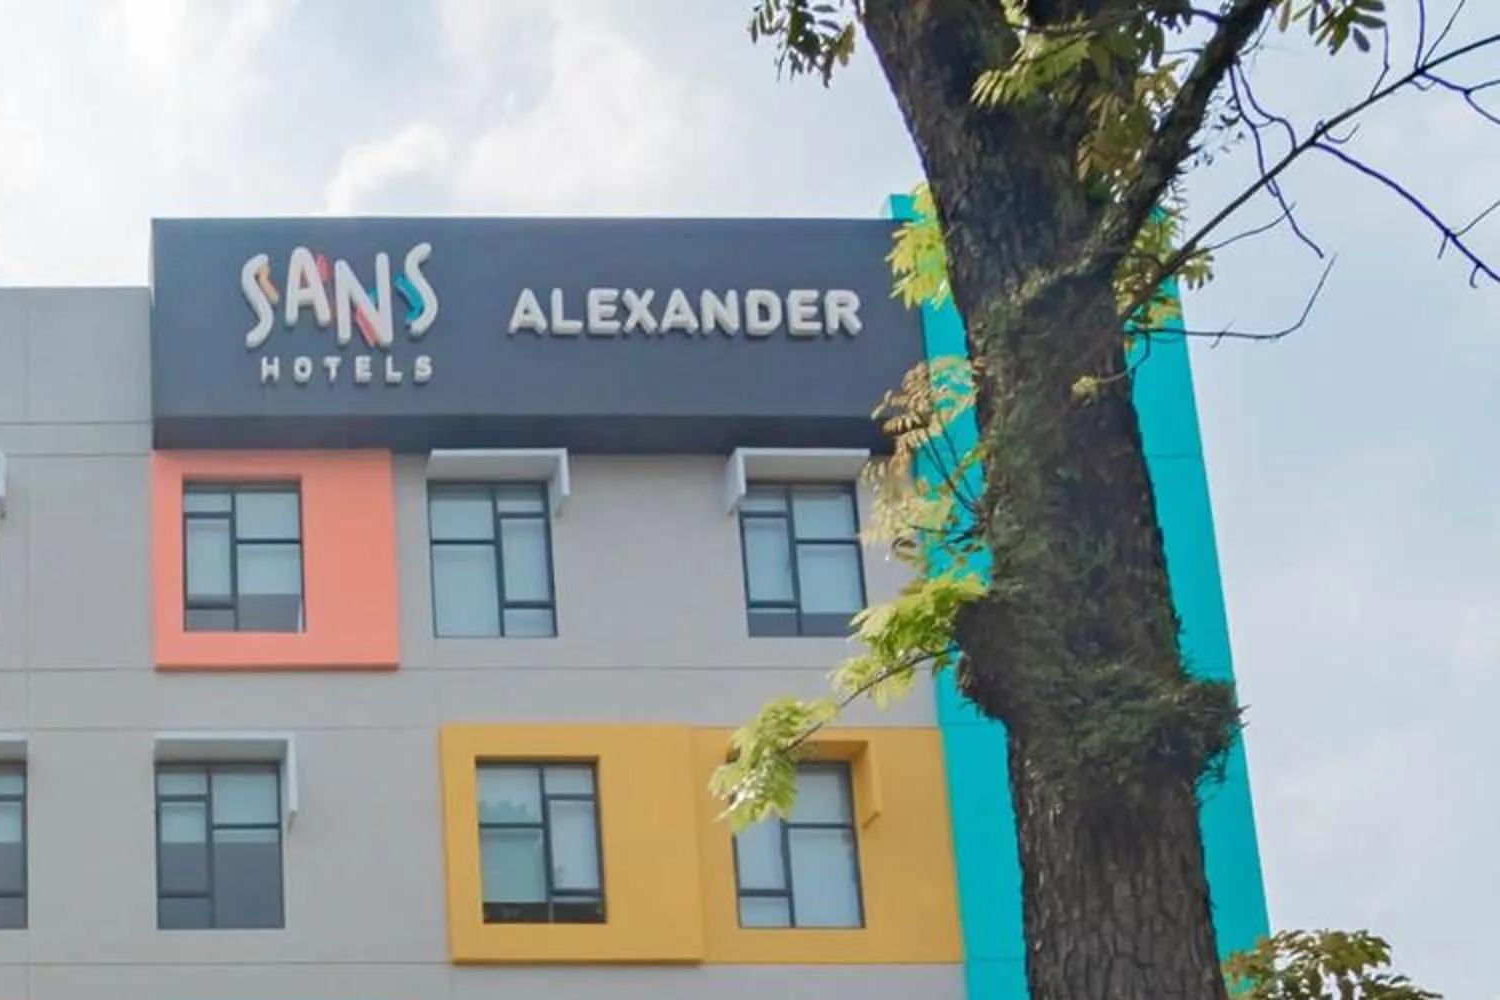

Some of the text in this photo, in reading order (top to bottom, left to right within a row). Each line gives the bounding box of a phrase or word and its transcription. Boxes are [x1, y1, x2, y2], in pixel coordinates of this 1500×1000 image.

[241, 242, 439, 348] SANS
[508, 287, 863, 337] ALEXANDER
[260, 353, 435, 385] HOTELS
